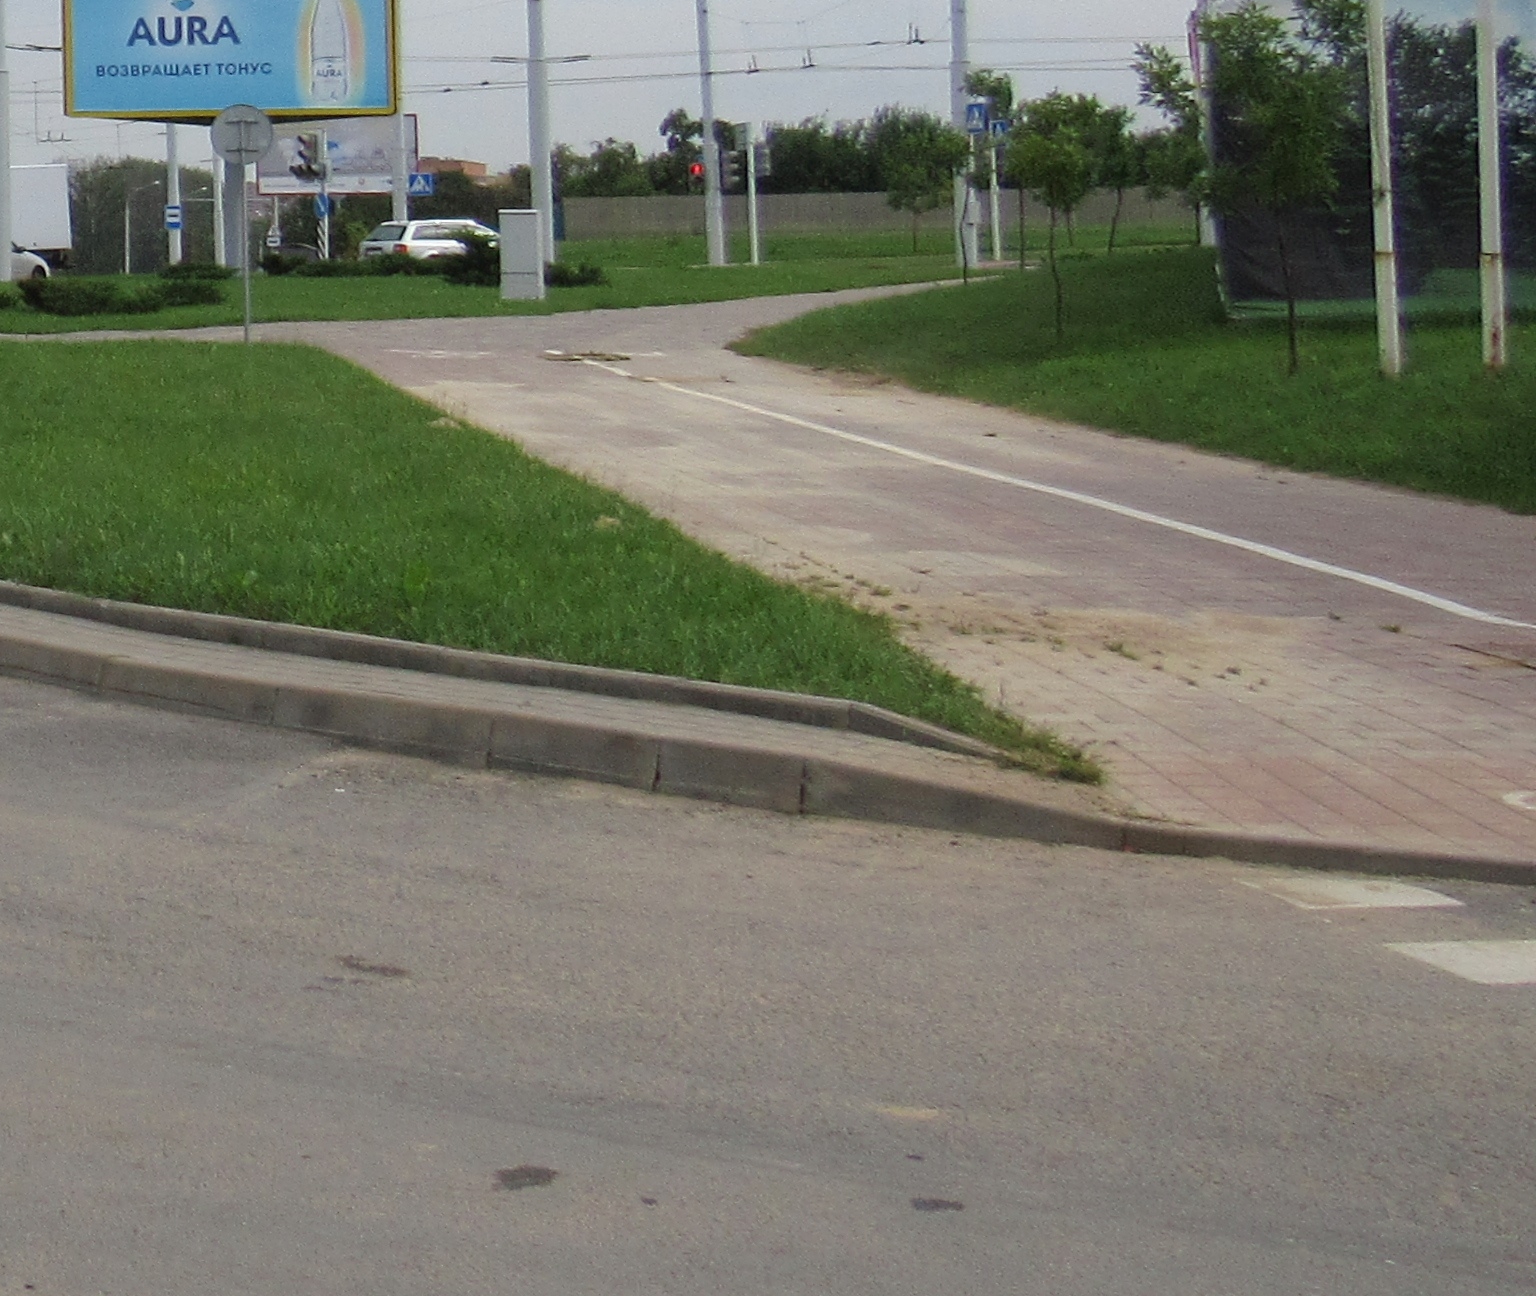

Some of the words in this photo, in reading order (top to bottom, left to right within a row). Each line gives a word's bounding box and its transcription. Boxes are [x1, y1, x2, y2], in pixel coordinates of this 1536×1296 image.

[126, 15, 241, 47] AURA
[96, 62, 212, 78] ВОЗВРАЩАЕТ
[216, 62, 273, 76] ТОНУС
[315, 68, 343, 79] AURA
